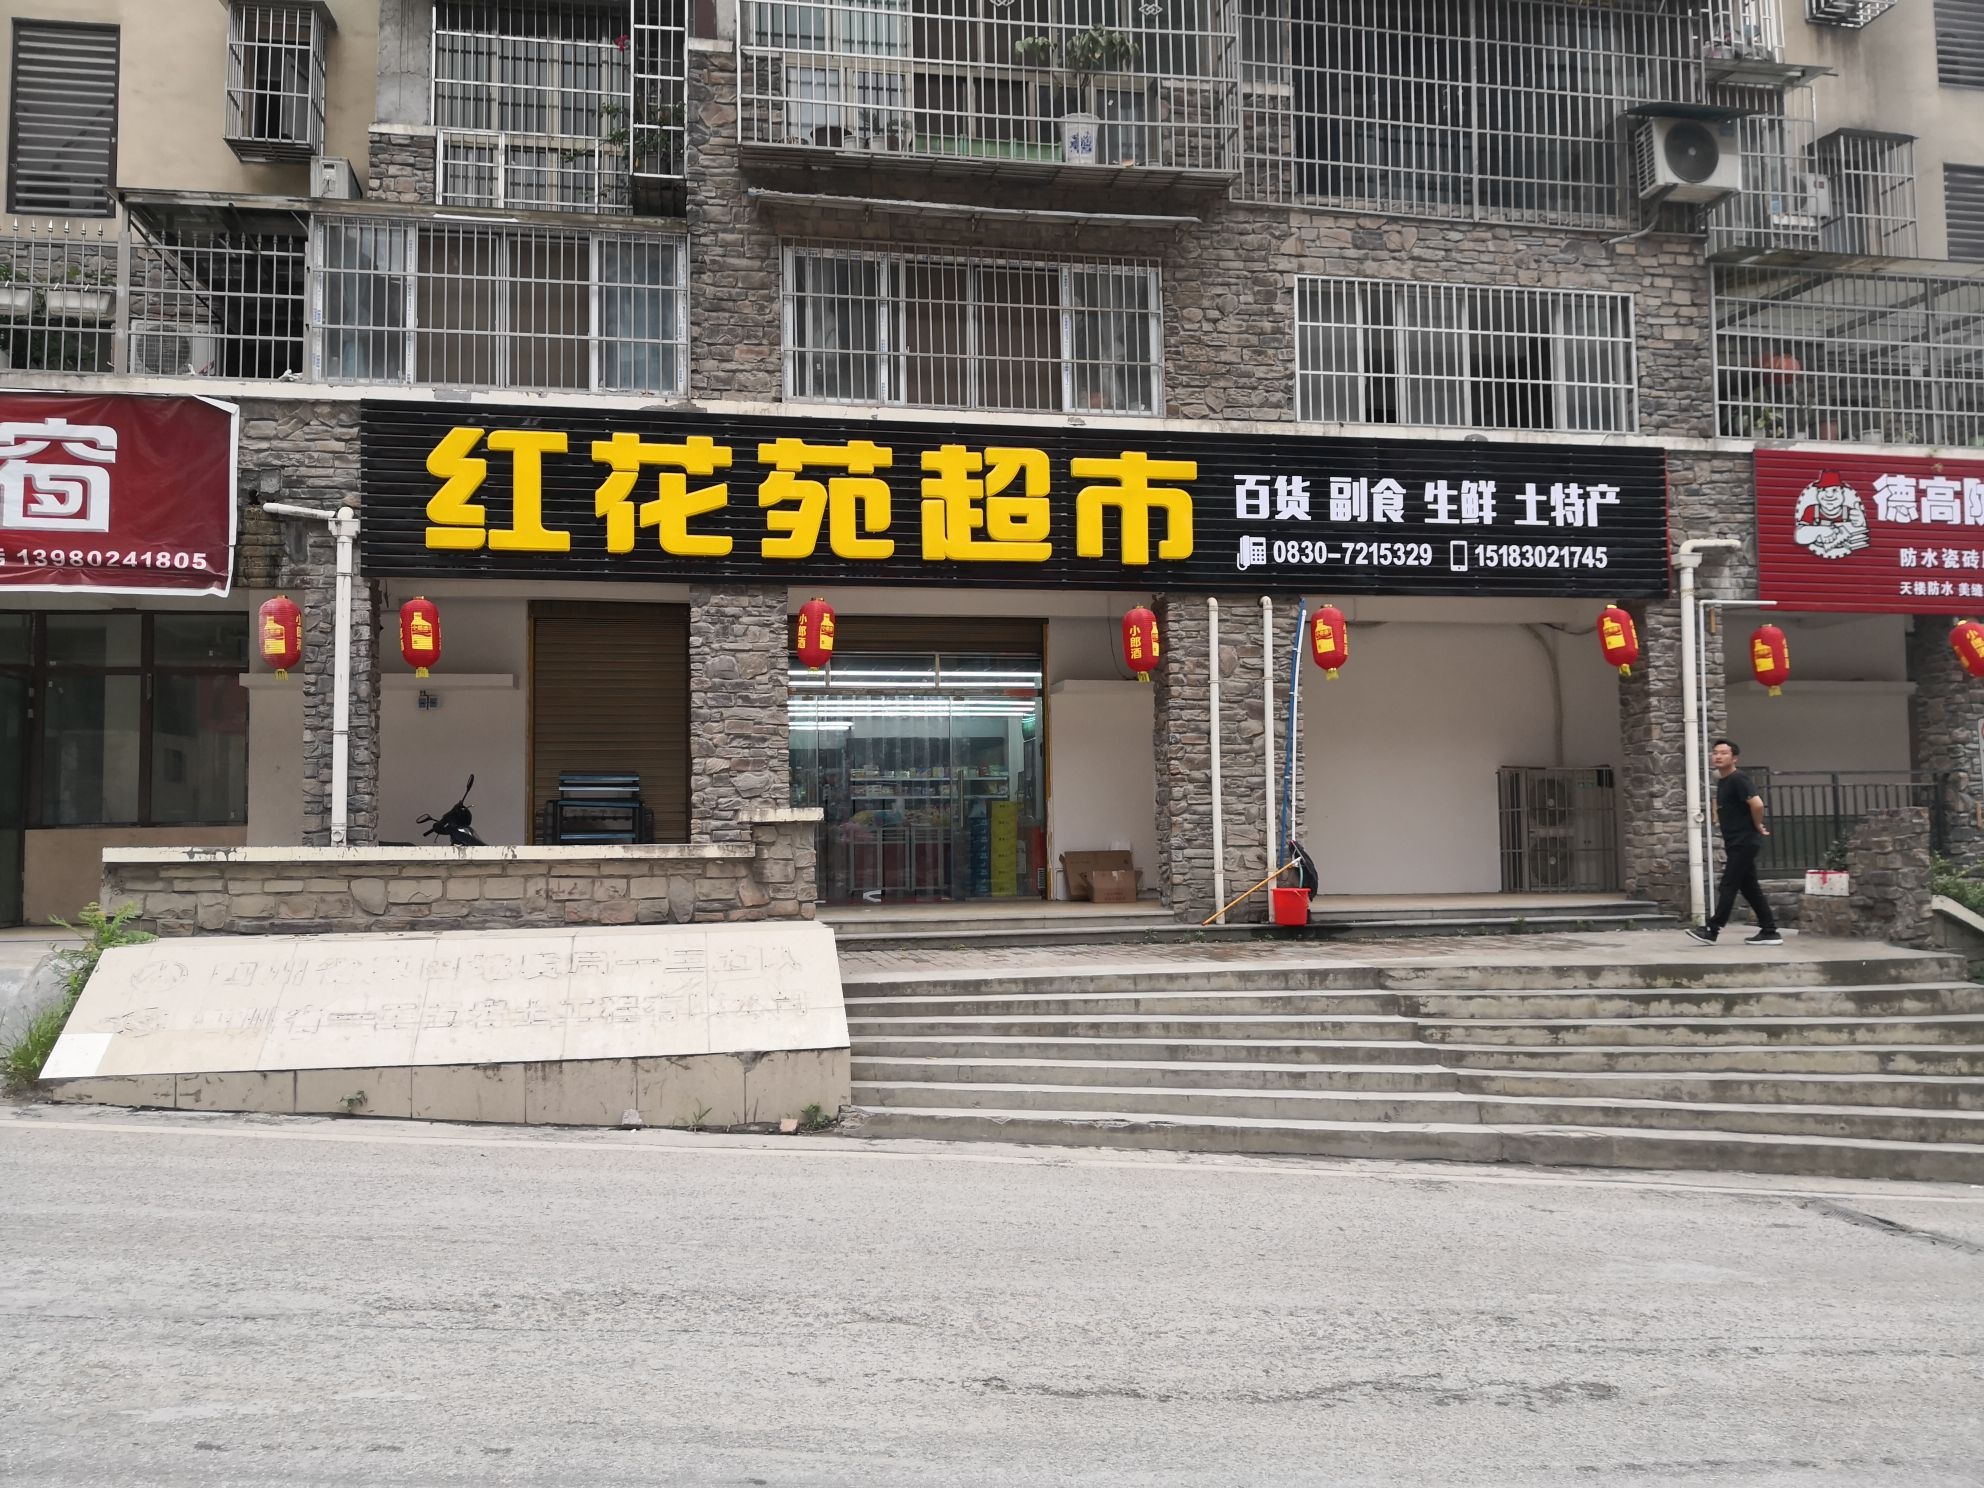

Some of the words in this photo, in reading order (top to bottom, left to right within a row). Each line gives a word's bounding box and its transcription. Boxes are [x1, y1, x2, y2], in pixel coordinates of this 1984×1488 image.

[0, 418, 118, 532] 窗
[425, 427, 1198, 565] 红花苑超市
[1234, 475, 1312, 520] 百货
[1329, 477, 1407, 523] 副食
[1424, 480, 1497, 525] 生鲜
[1514, 483, 1620, 527] 土特产
[17, 548, 207, 570] 13980241805
[1273, 540, 1433, 566] 0830-7215329
[1474, 544, 1608, 568] 15183021745
[1900, 547, 1984, 569] 防水瓷砖
[1129, 624, 1142, 659] 小郎酒
